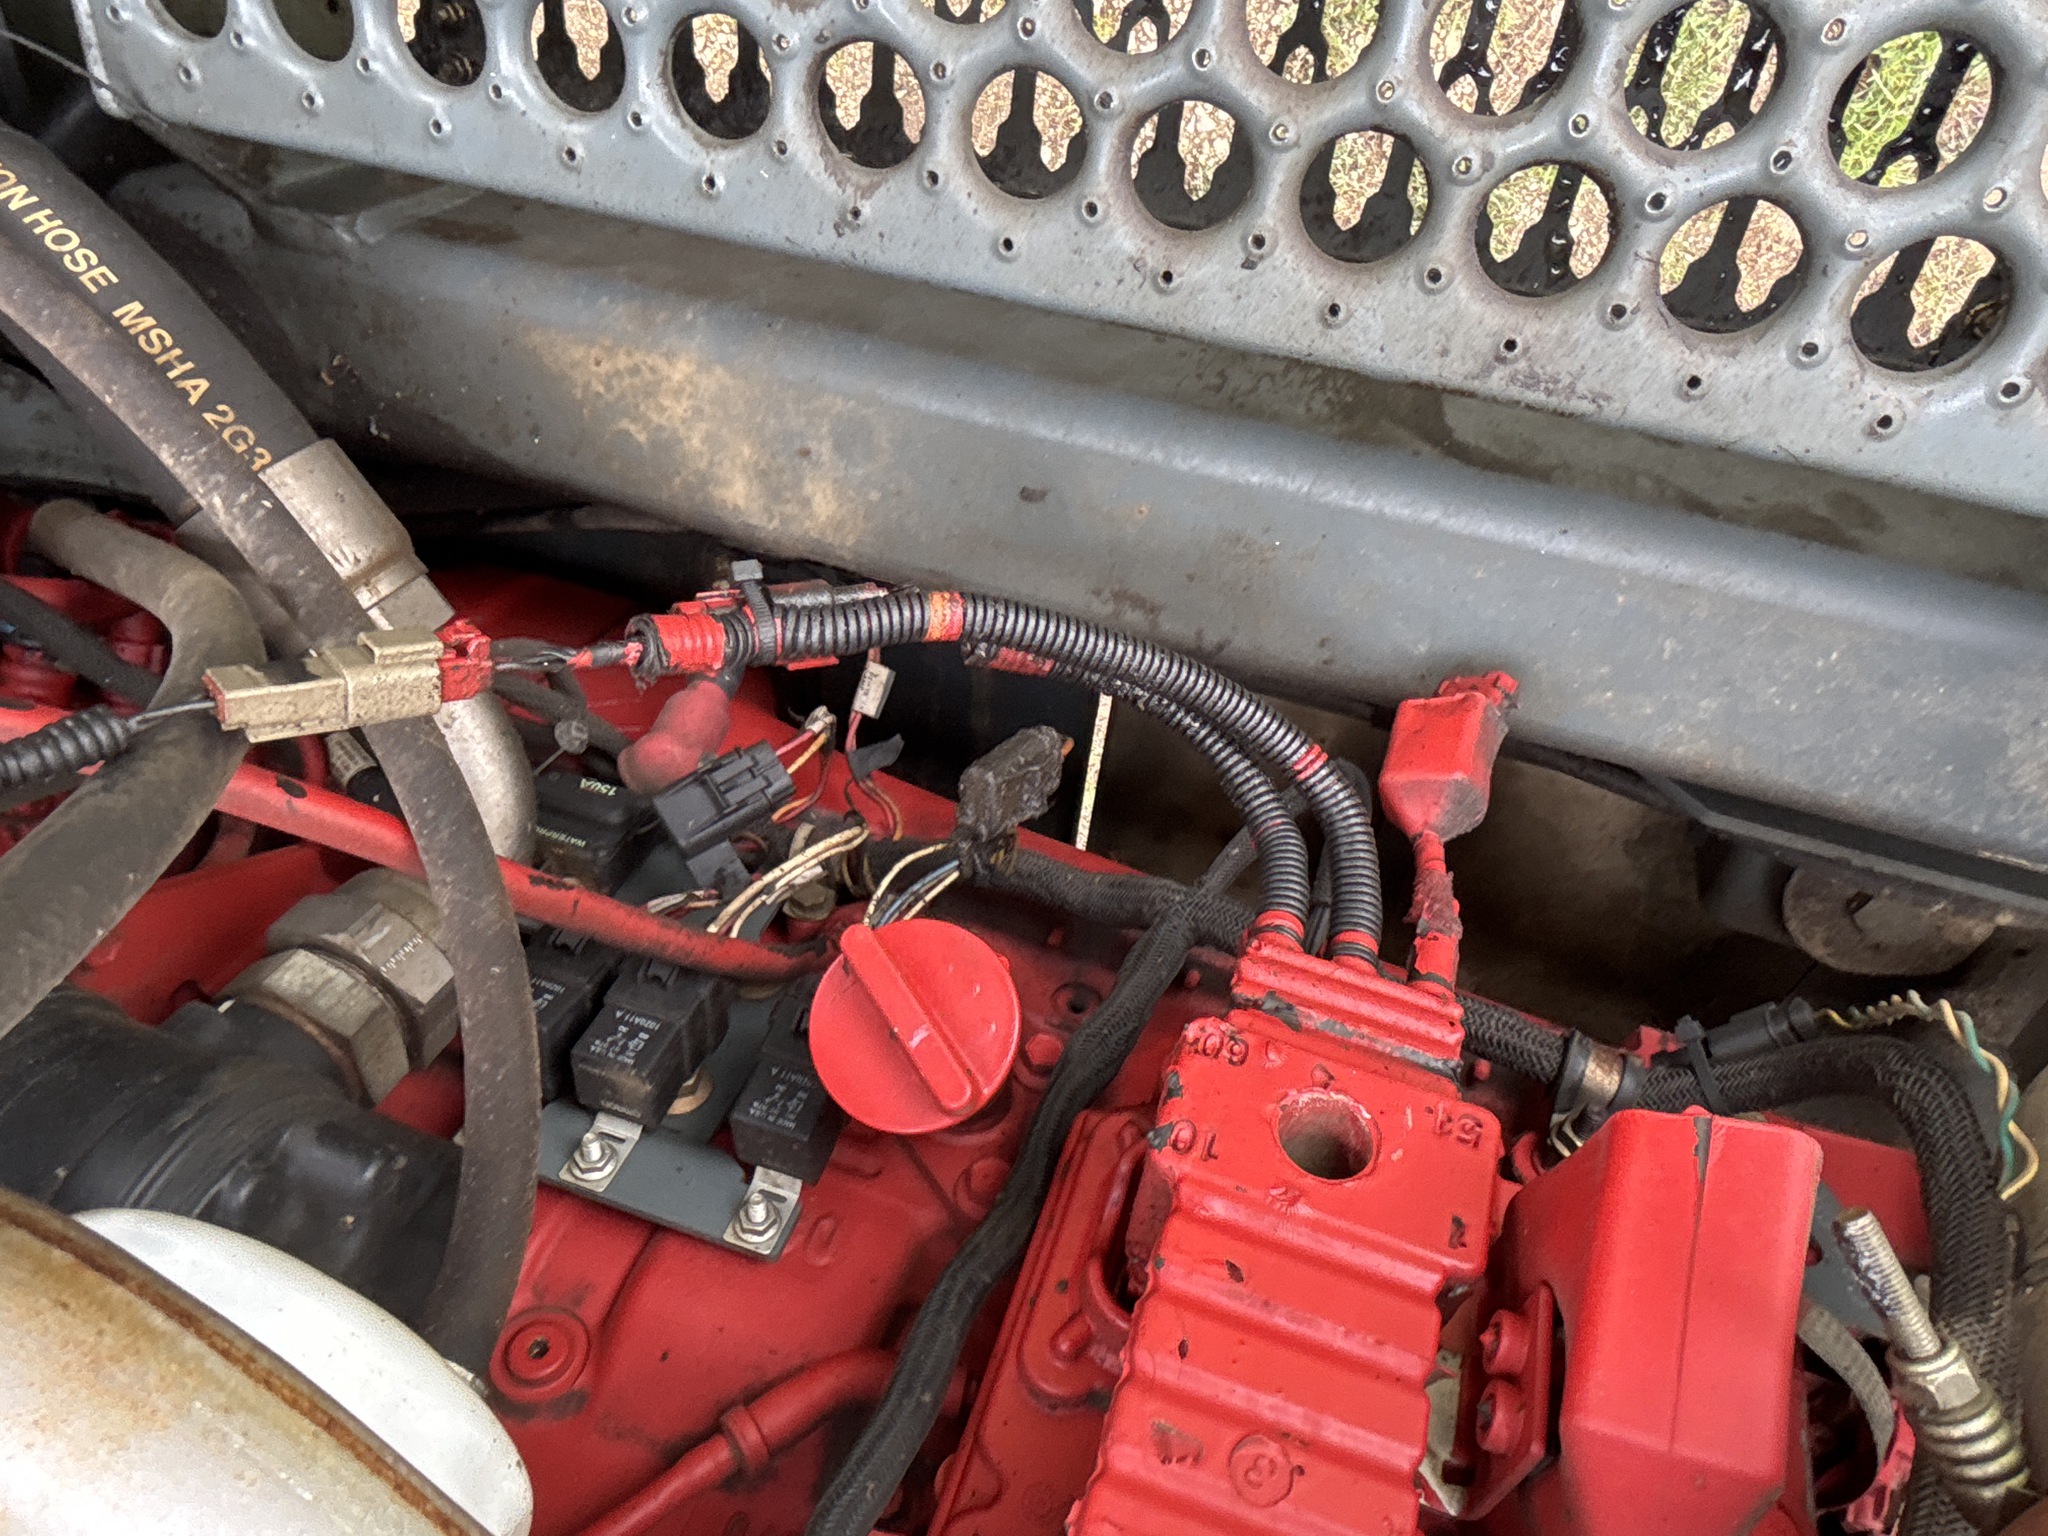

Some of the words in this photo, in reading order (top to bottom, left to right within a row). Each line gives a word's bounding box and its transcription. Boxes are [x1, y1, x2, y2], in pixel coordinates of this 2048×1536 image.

[0, 163, 39, 211] ON
[22, 208, 119, 294] HOSE
[112, 300, 211, 406] MSHA
